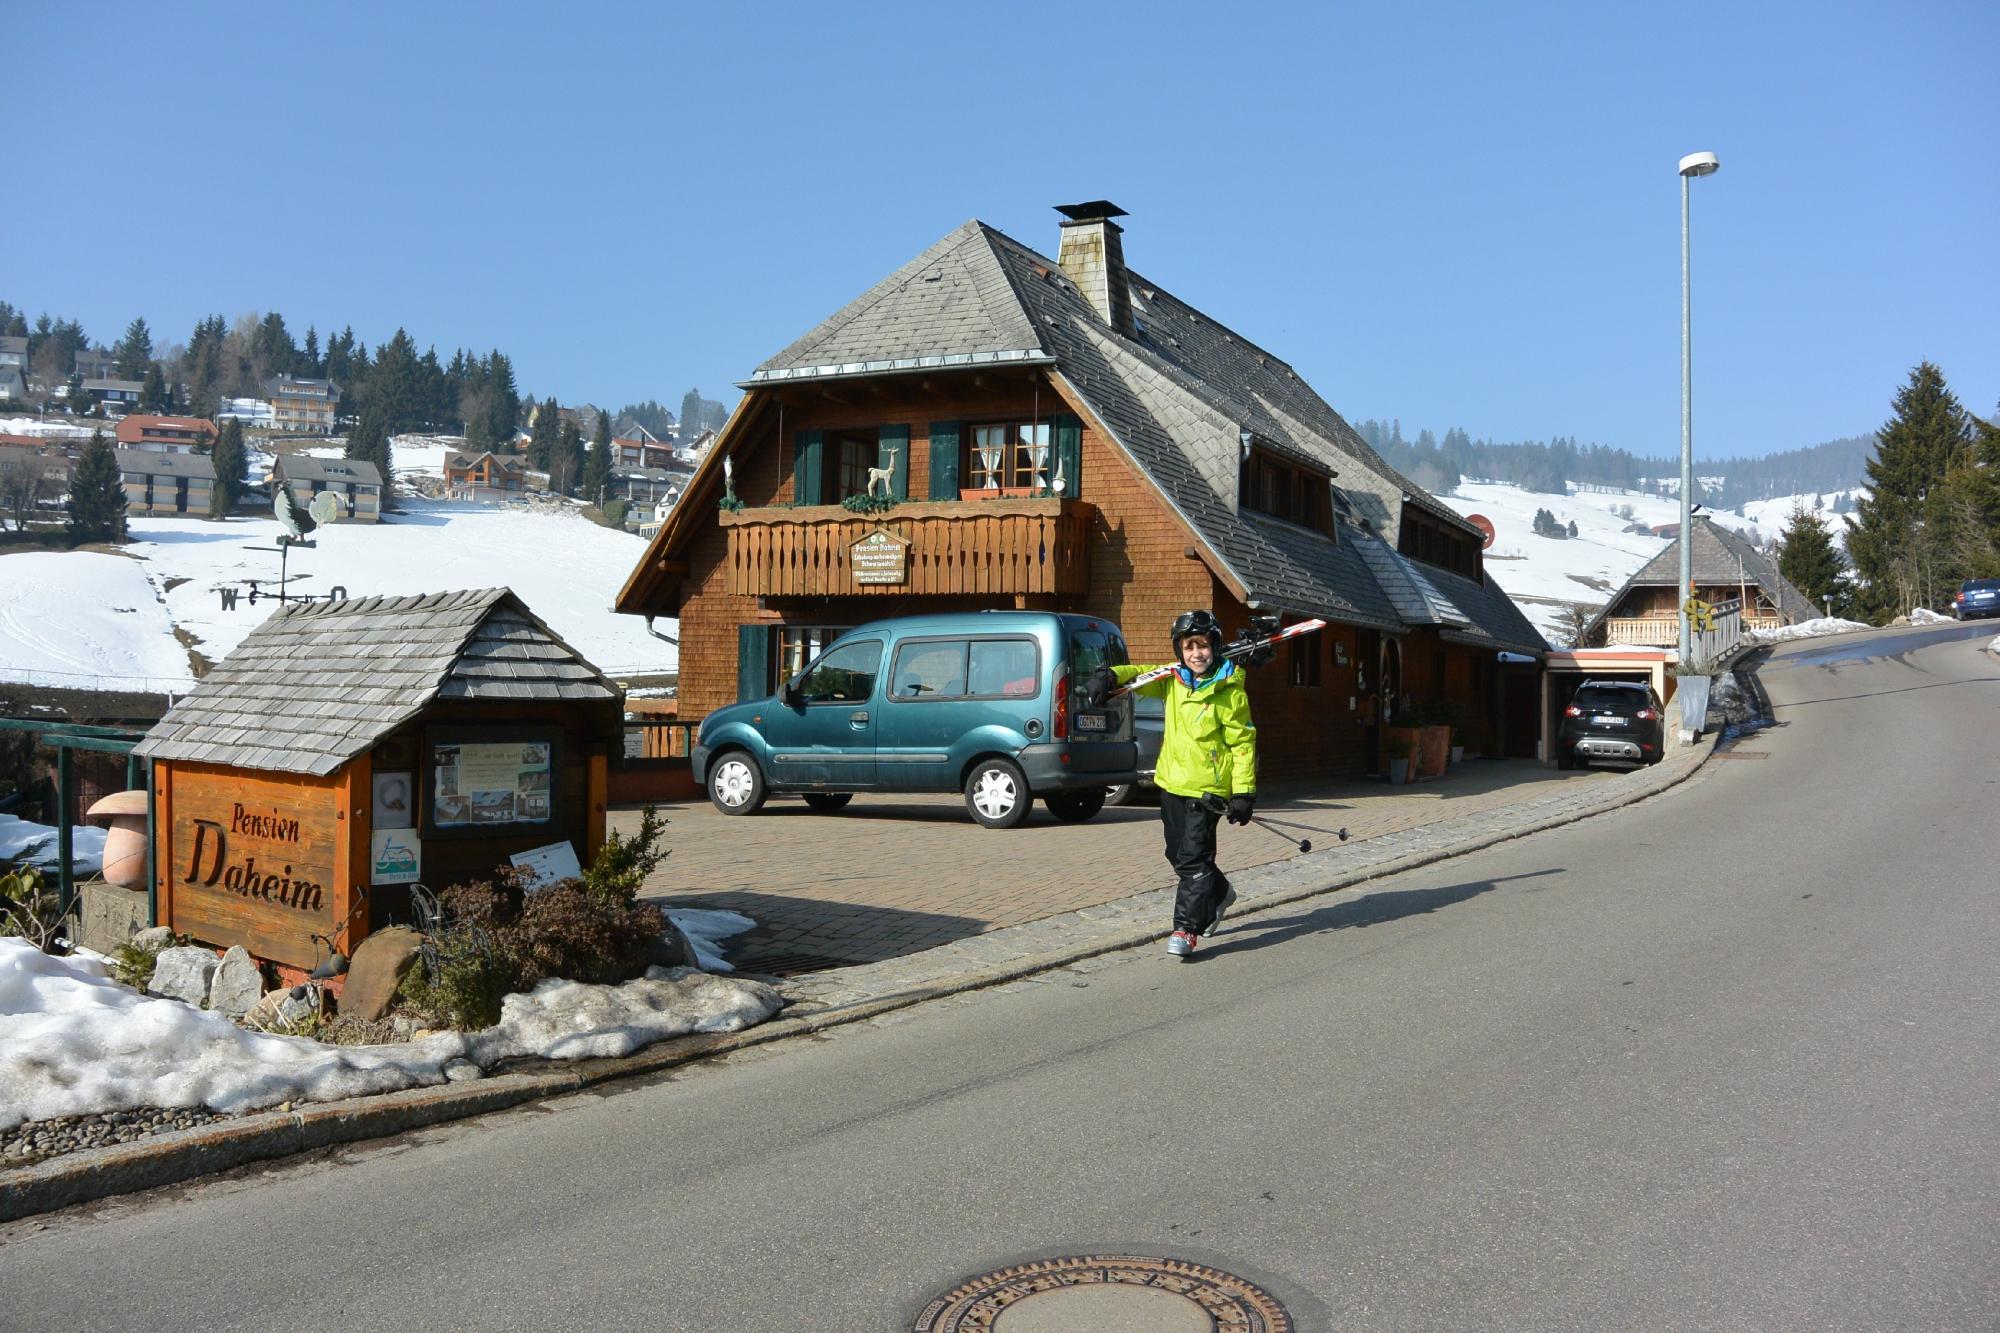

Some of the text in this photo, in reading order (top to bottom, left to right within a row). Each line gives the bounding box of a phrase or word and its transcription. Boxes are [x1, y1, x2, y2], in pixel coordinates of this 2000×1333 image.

[221, 588, 239, 611] W
[231, 803, 299, 843] Pension
[184, 818, 323, 912] Daheim
